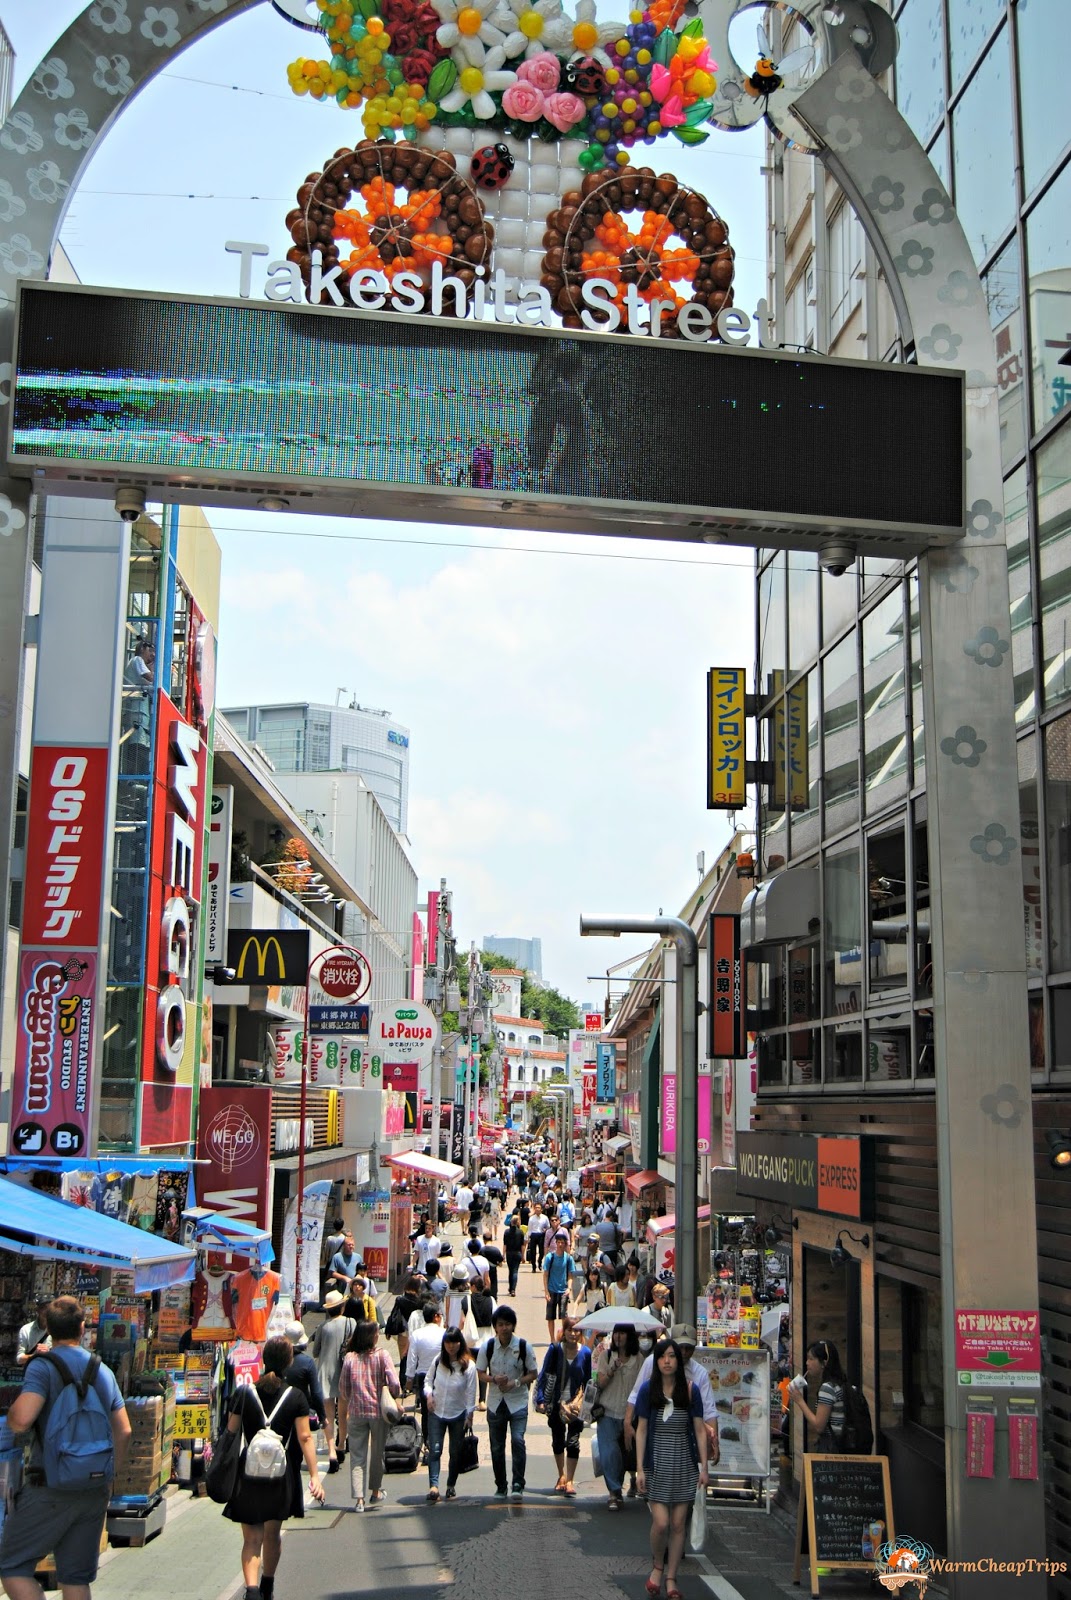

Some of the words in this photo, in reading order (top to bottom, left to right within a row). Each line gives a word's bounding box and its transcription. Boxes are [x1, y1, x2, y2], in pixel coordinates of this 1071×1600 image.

[225, 240, 552, 327] Takeshita
[581, 279, 775, 349] Street
[716, 670, 742, 789] コインロッカー
[715, 793, 742, 803] 3F
[42, 756, 88, 939] OSドラッグ
[322, 967, 359, 986] 消火栓
[716, 958, 730, 1013] 吉野家
[58, 996, 80, 1036] プリ
[321, 1011, 358, 1020] 東郷神社
[395, 1011, 418, 1019] ラパウザ
[275, 1029, 291, 1041] La
[321, 1021, 360, 1030] 東郷記念館
[381, 1022, 394, 1038] La
[397, 1022, 432, 1040] Pausa
[24, 962, 66, 1112] eggnam
[311, 1038, 323, 1049] La
[61, 1039, 73, 1090] STUDIO
[76, 998, 91, 1112] ENTERTAINMENT
[274, 1043, 291, 1079] Pausa
[311, 1052, 323, 1082] Pausa
[665, 1078, 675, 1132] PURIKURA
[56, 1129, 79, 1149] B1
[212, 1129, 231, 1144] WE
[235, 1130, 254, 1144] GO
[740, 1153, 788, 1183] WOLFGANG
[788, 1158, 815, 1188] PUCK
[820, 1164, 858, 1191] EXPRESS
[102, 1186, 123, 1212] 侍
[76, 1277, 100, 1285] JAPAN
[957, 1314, 1038, 1331] 竹下通り公式マップ
[702, 1357, 729, 1365] Dessert
[174, 1409, 207, 1418] 料で
[174, 1418, 207, 1426] 名前
